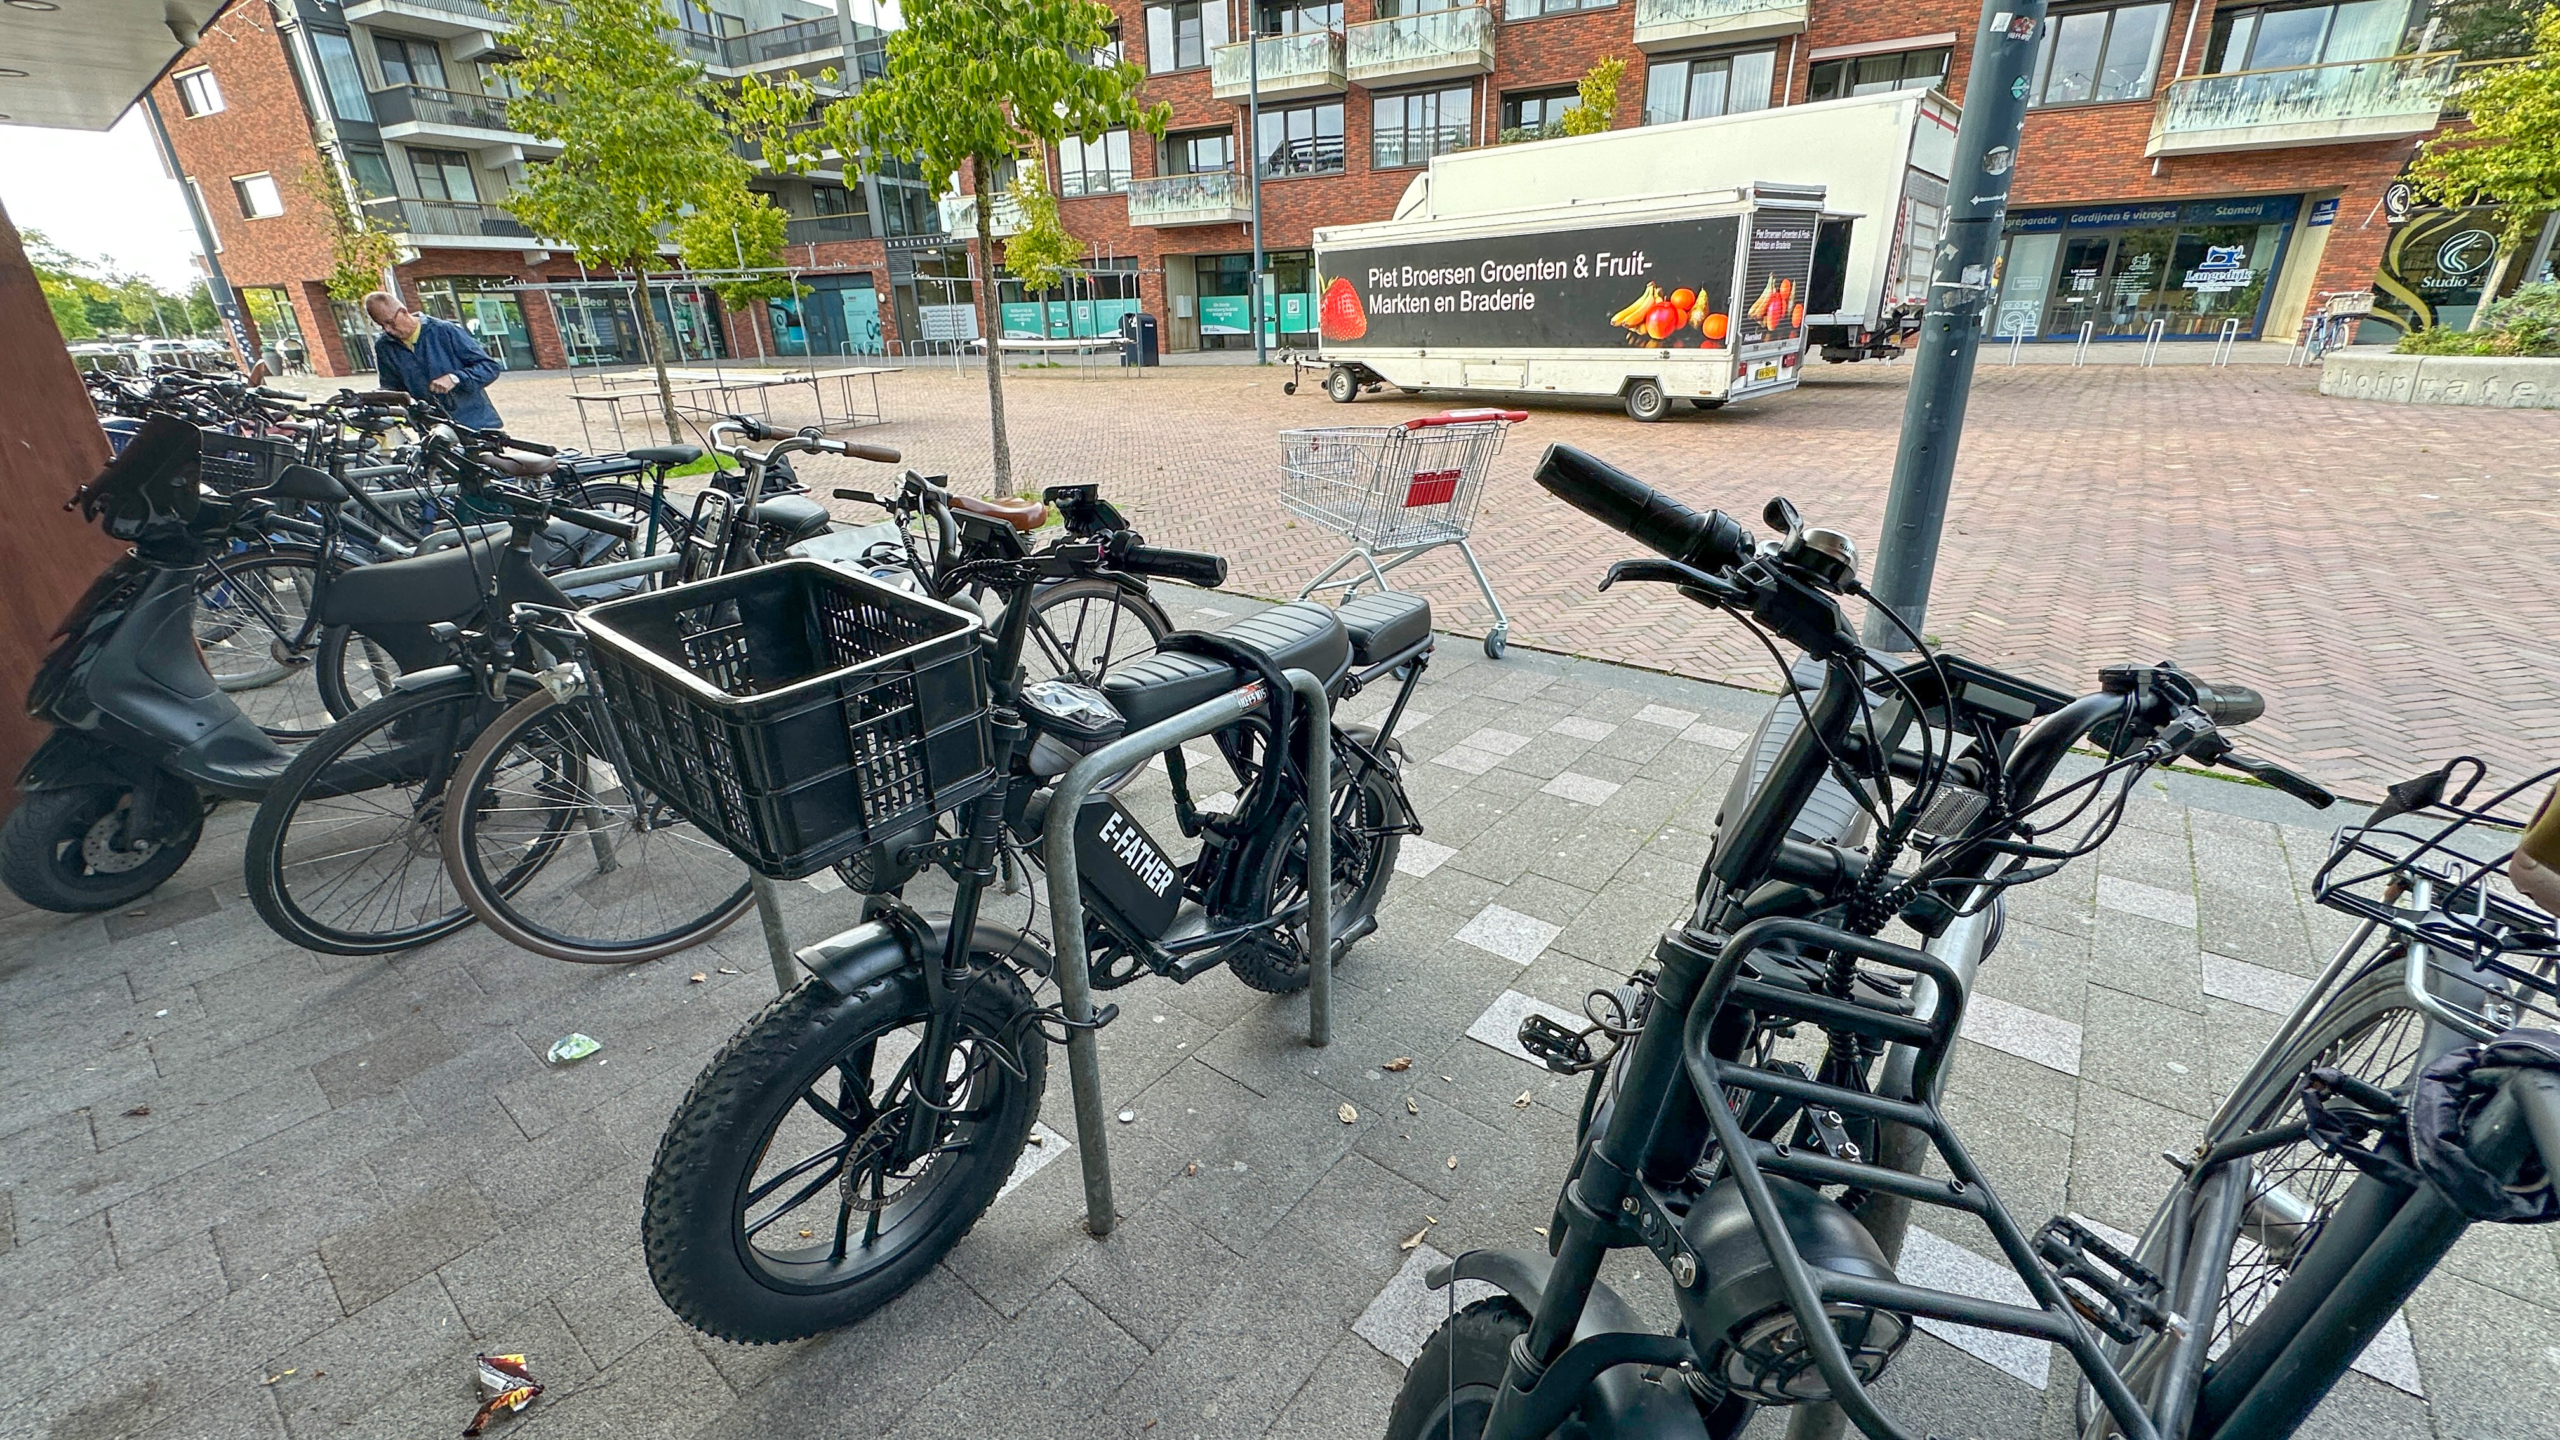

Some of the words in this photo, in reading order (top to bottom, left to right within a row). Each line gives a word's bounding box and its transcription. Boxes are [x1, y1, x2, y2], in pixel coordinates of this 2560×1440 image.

[2070, 212, 2120, 224] Gordijnen
[2122, 211, 2131, 221] &
[2133, 210, 2177, 221] vitrages
[2215, 203, 2263, 217] Stomerij
[1368, 267, 1398, 289] Piet
[1402, 264, 1475, 288] Broersen
[1480, 257, 1567, 284] Groenten
[1573, 253, 1589, 279] &
[1595, 250, 1653, 278] Fruit-
[2185, 269, 2253, 284] Langedijk
[2421, 275, 2468, 288] Studio
[1369, 292, 1430, 315] Markten
[1434, 295, 1455, 313] en
[1460, 287, 1536, 313] Braderie
[1098, 811, 1175, 898] E-FATHER
